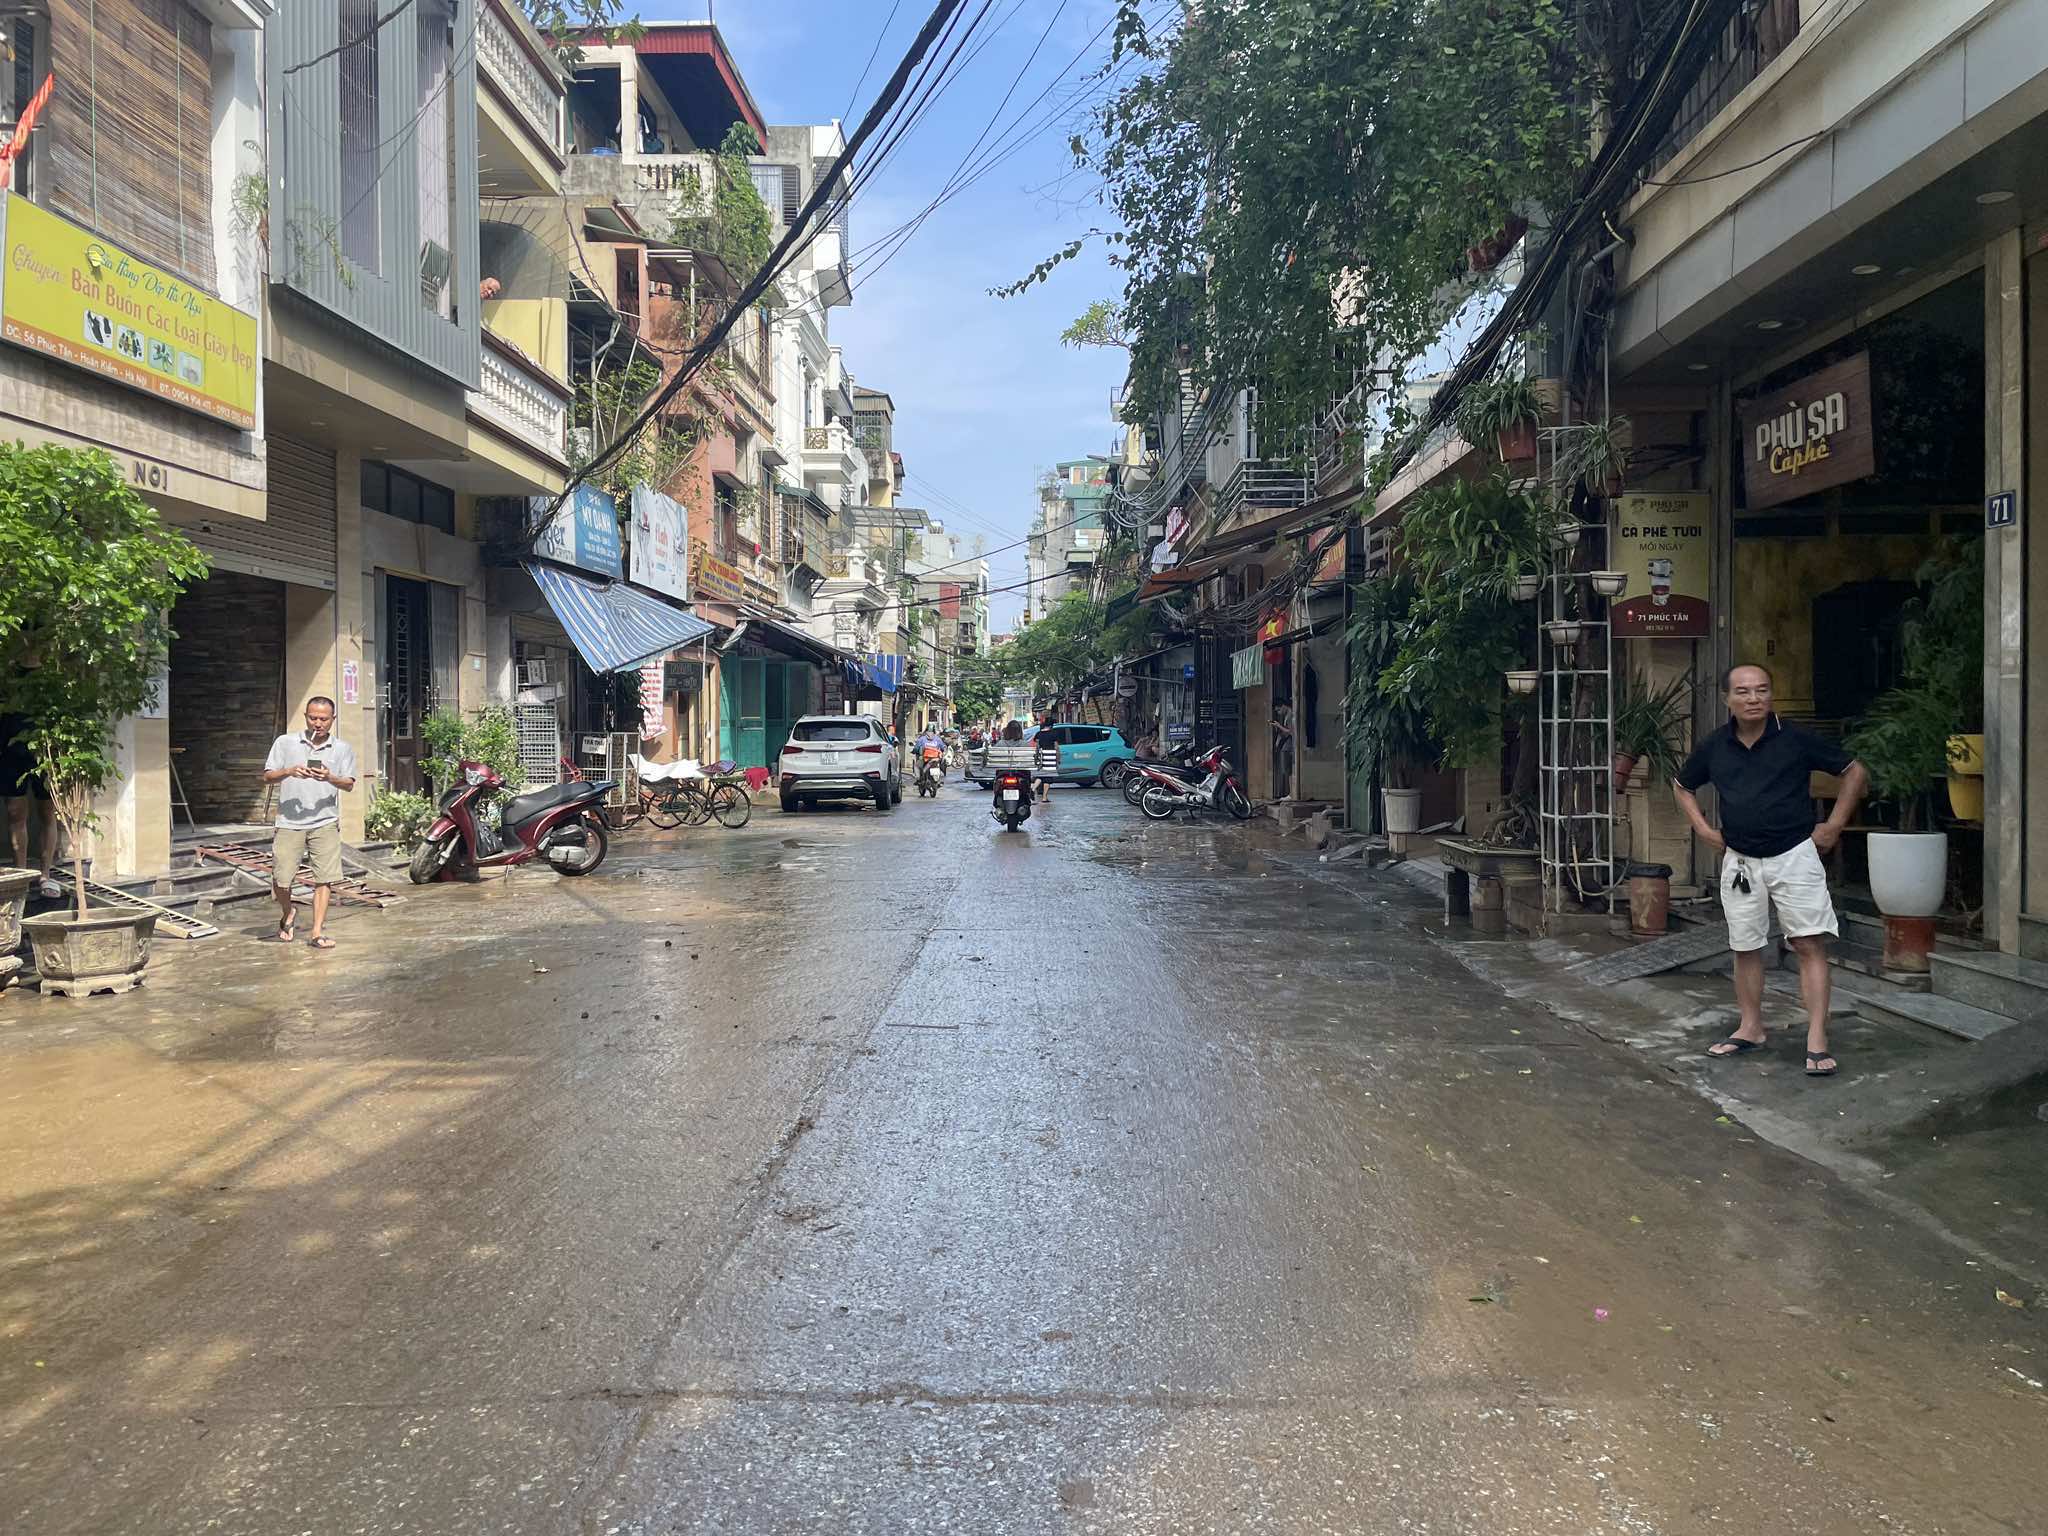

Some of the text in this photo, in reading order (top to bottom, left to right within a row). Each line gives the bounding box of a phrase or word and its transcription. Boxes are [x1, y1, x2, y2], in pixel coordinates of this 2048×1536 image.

[1756, 392, 1846, 461] PHÙ SA
[1992, 498, 2008, 521] 71
[1638, 614, 1646, 622] 71
